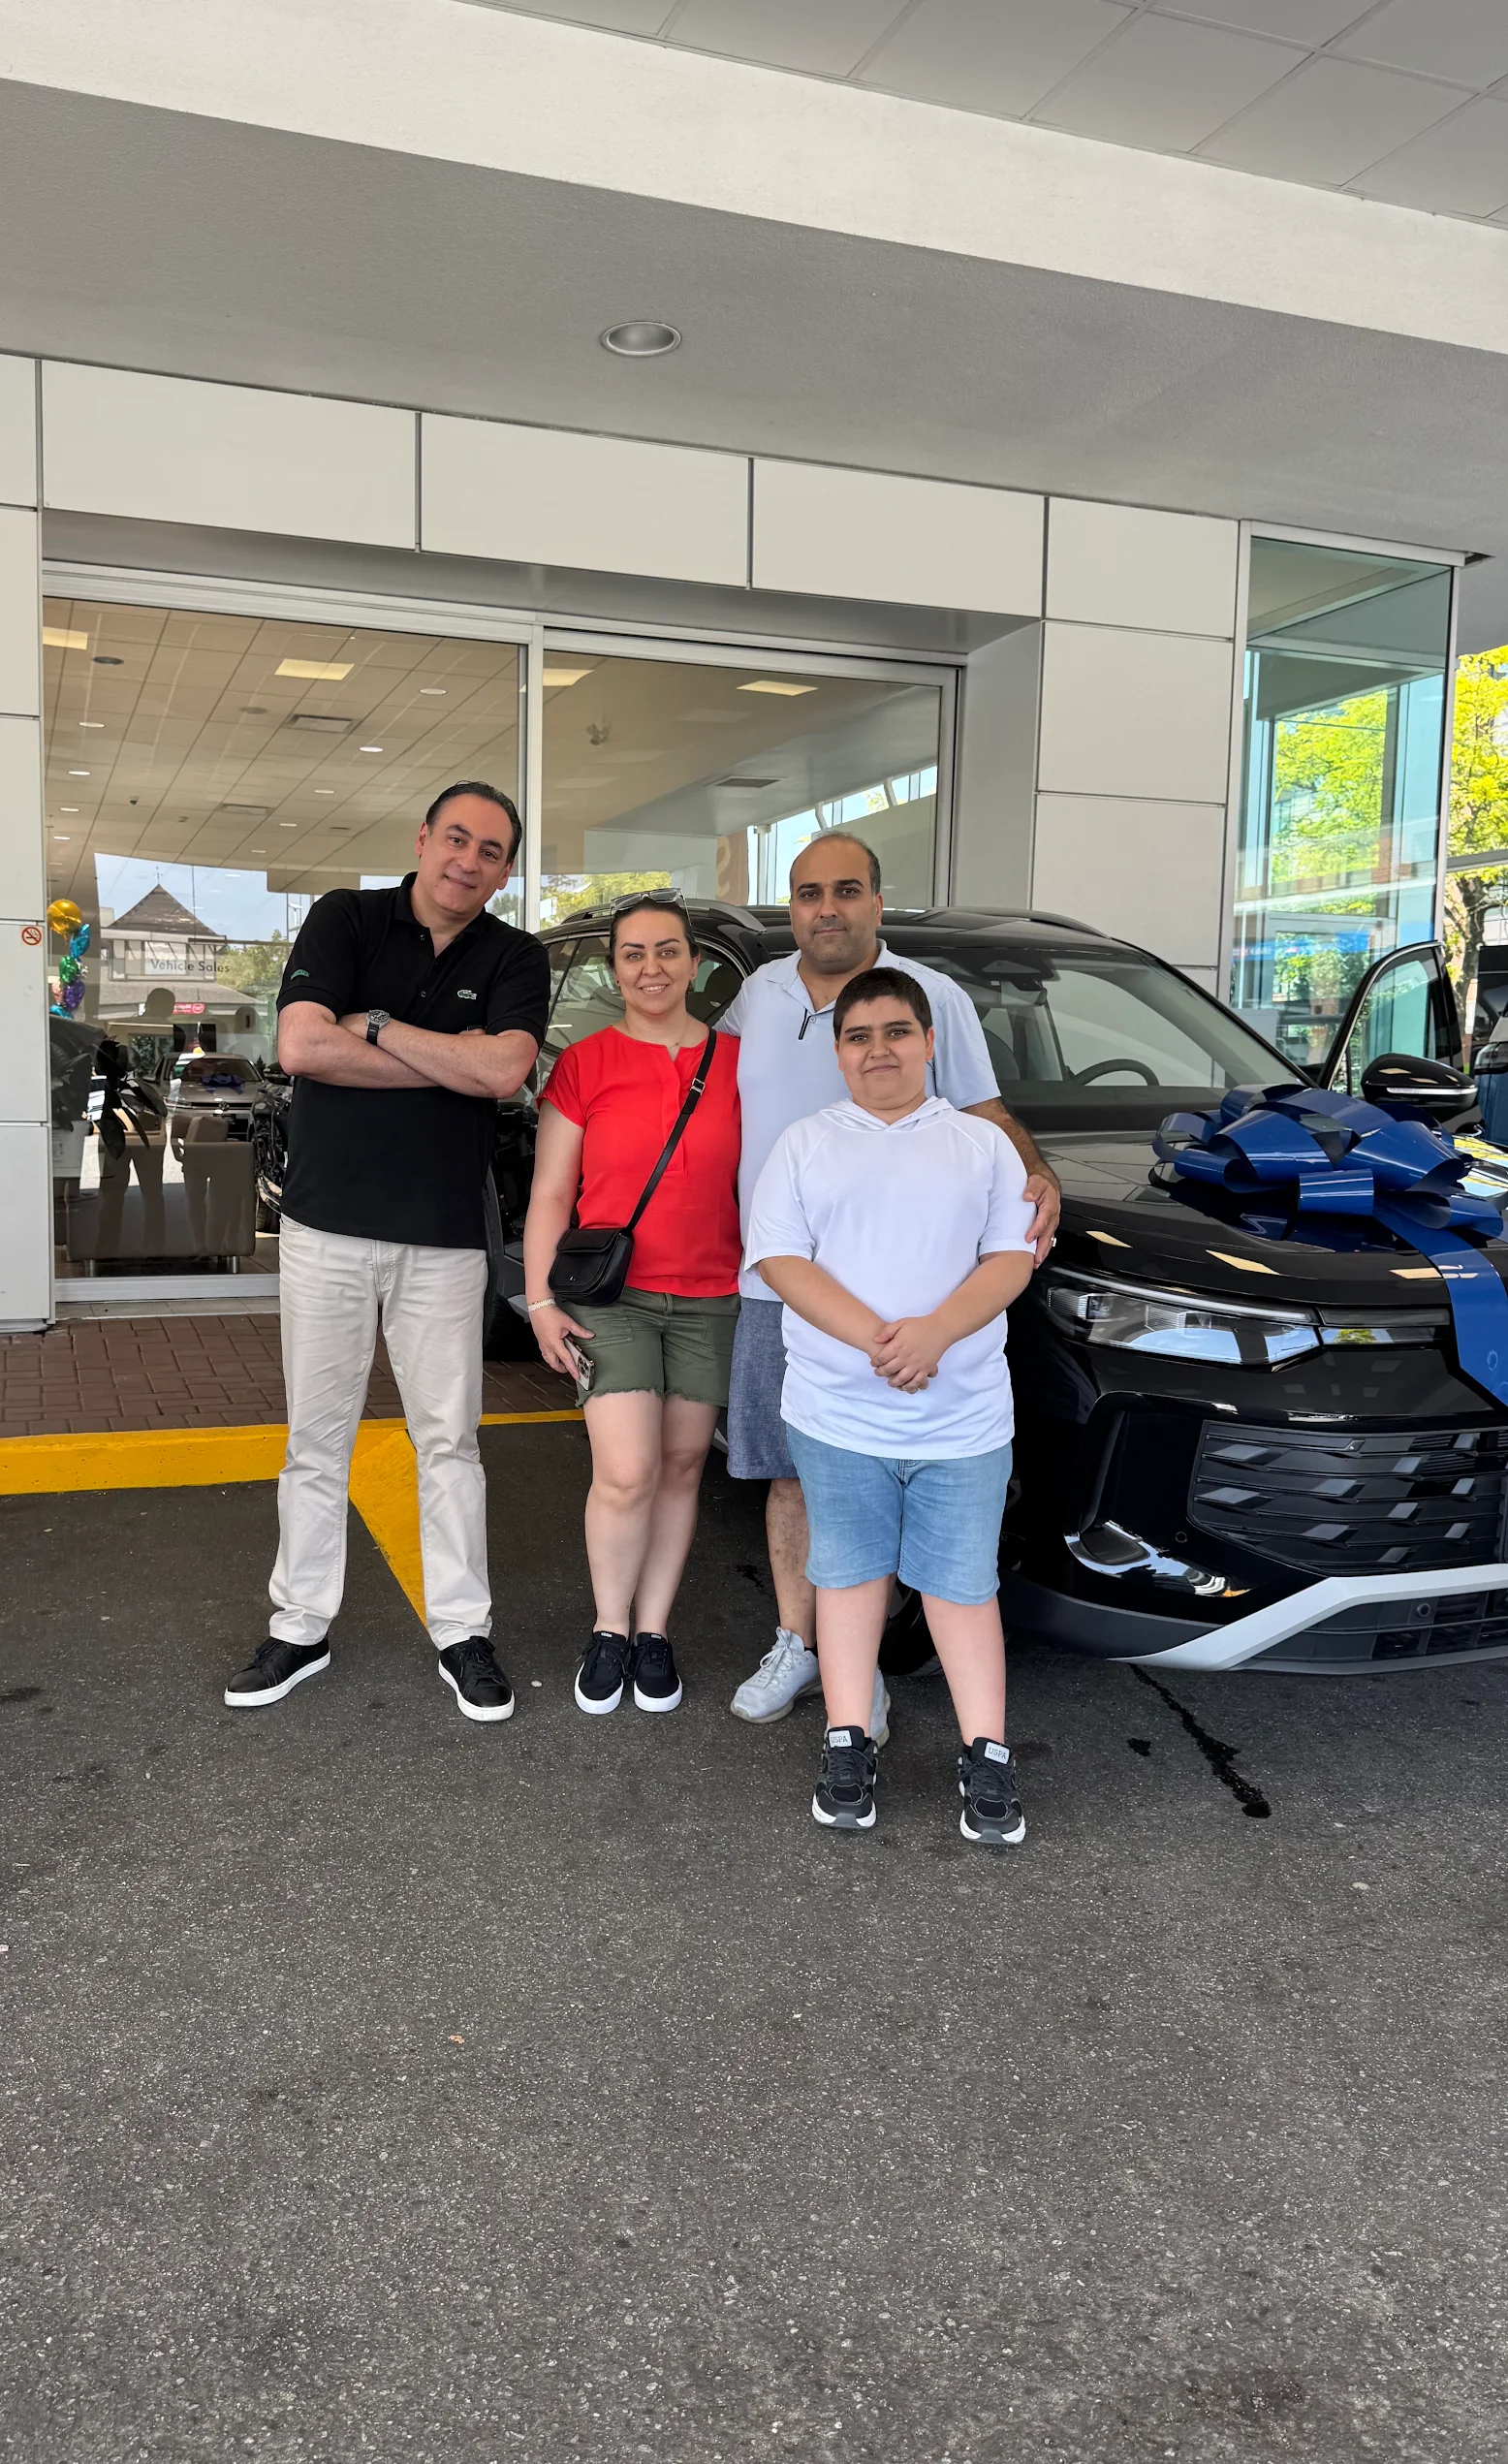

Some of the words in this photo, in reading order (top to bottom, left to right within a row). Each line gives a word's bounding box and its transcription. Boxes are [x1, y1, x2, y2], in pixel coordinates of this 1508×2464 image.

[150, 959, 194, 970] Vehicle
[198, 961, 230, 972] Sales
[989, 1747, 1006, 1759] USPA
